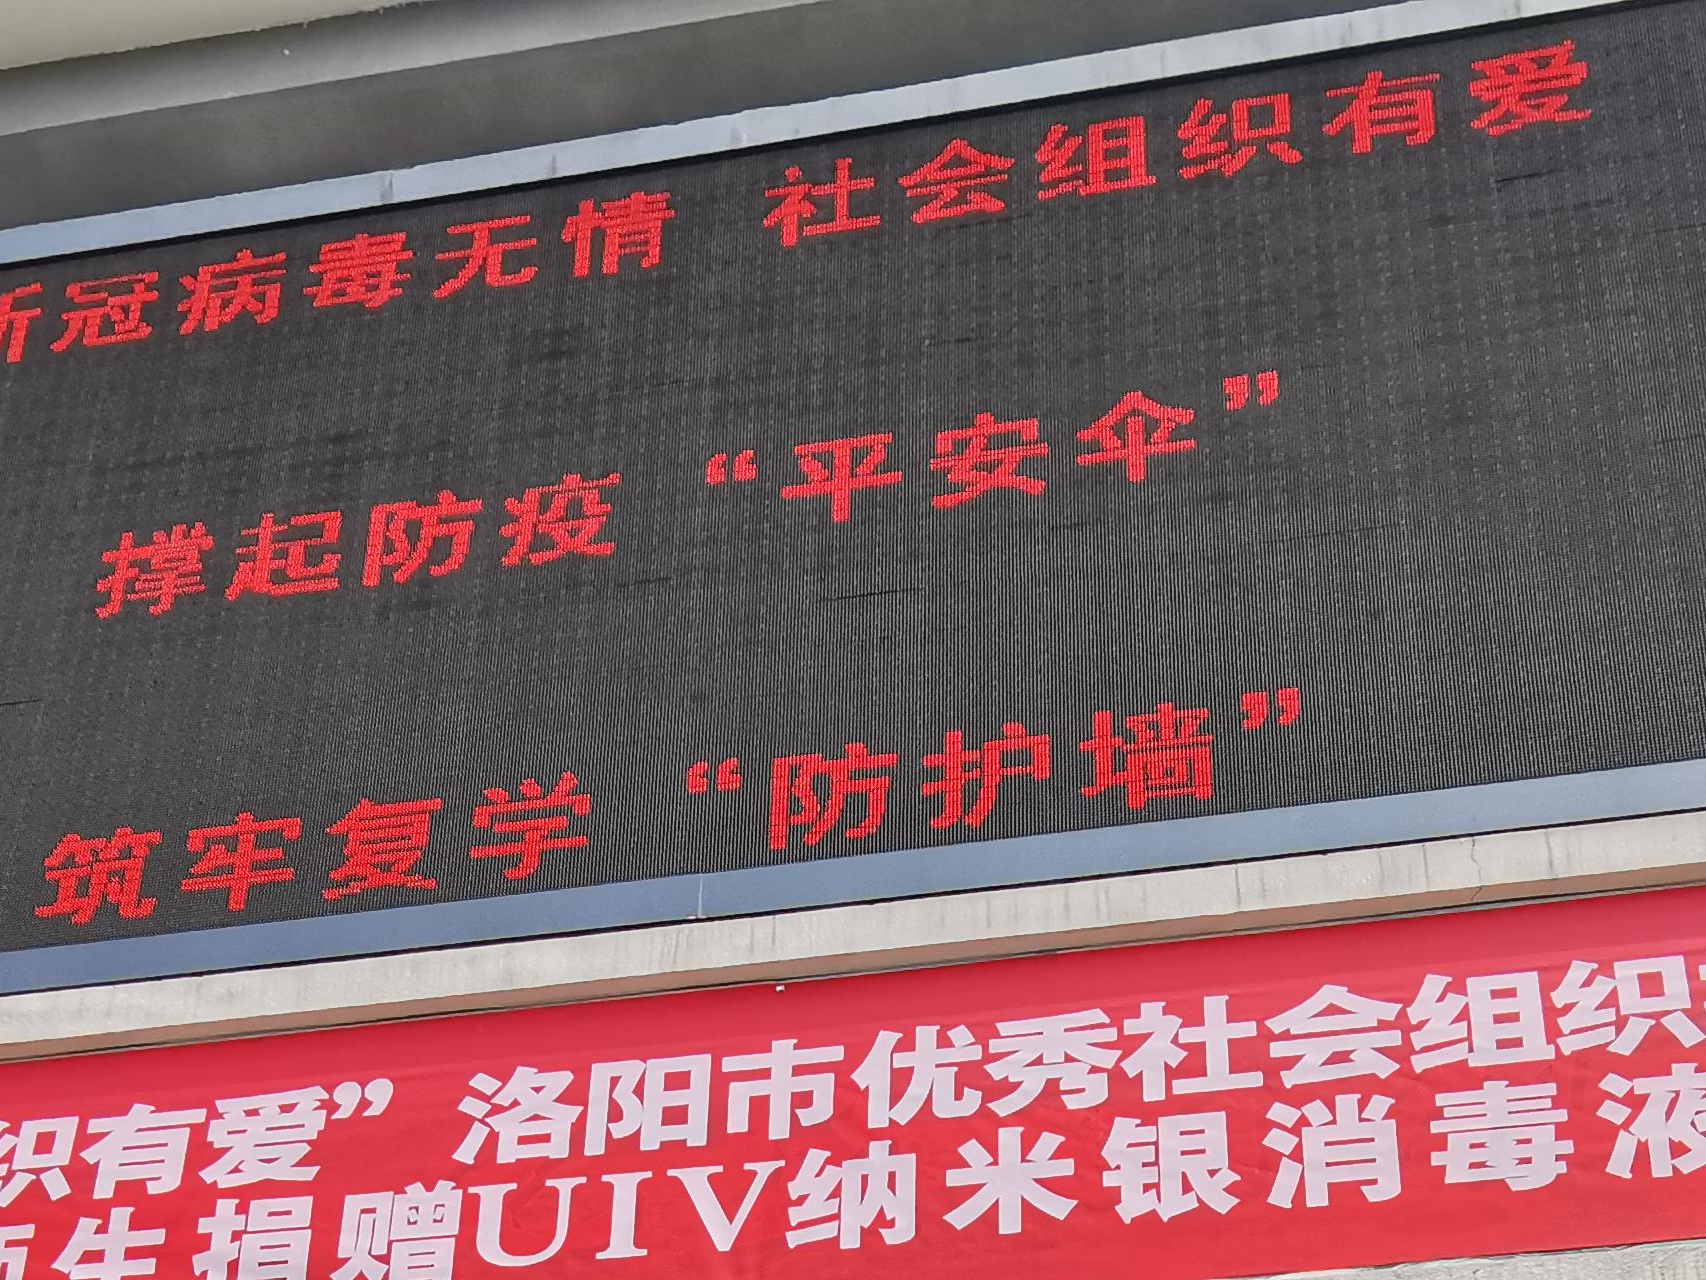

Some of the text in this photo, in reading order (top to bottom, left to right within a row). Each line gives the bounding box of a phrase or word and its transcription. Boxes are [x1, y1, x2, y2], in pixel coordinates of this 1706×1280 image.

[761, 38, 1592, 247] 社会组织有爱
